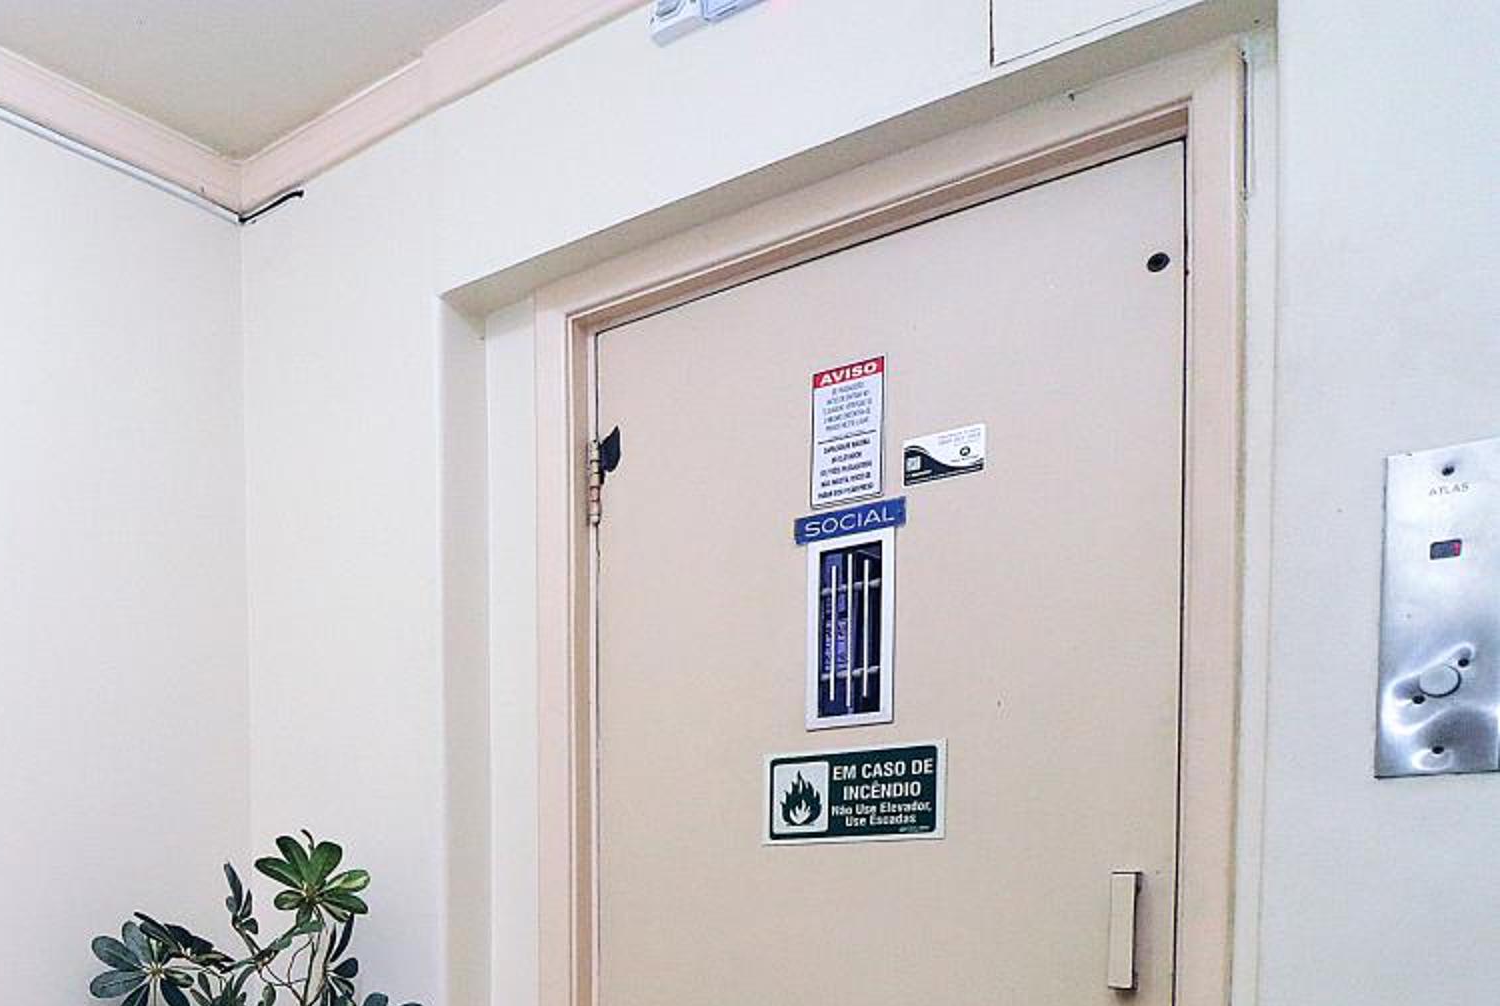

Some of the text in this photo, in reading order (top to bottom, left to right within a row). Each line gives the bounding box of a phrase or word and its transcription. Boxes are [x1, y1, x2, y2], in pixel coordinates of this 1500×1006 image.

[820, 362, 877, 386] AVISO
[805, 506, 895, 537] SOCIAL
[833, 758, 933, 780] EM CASO DE
[843, 780, 921, 800] INCÊNDIO
[831, 805, 853, 816] Não
[855, 803, 877, 815] Use
[845, 816, 867, 827] Use
